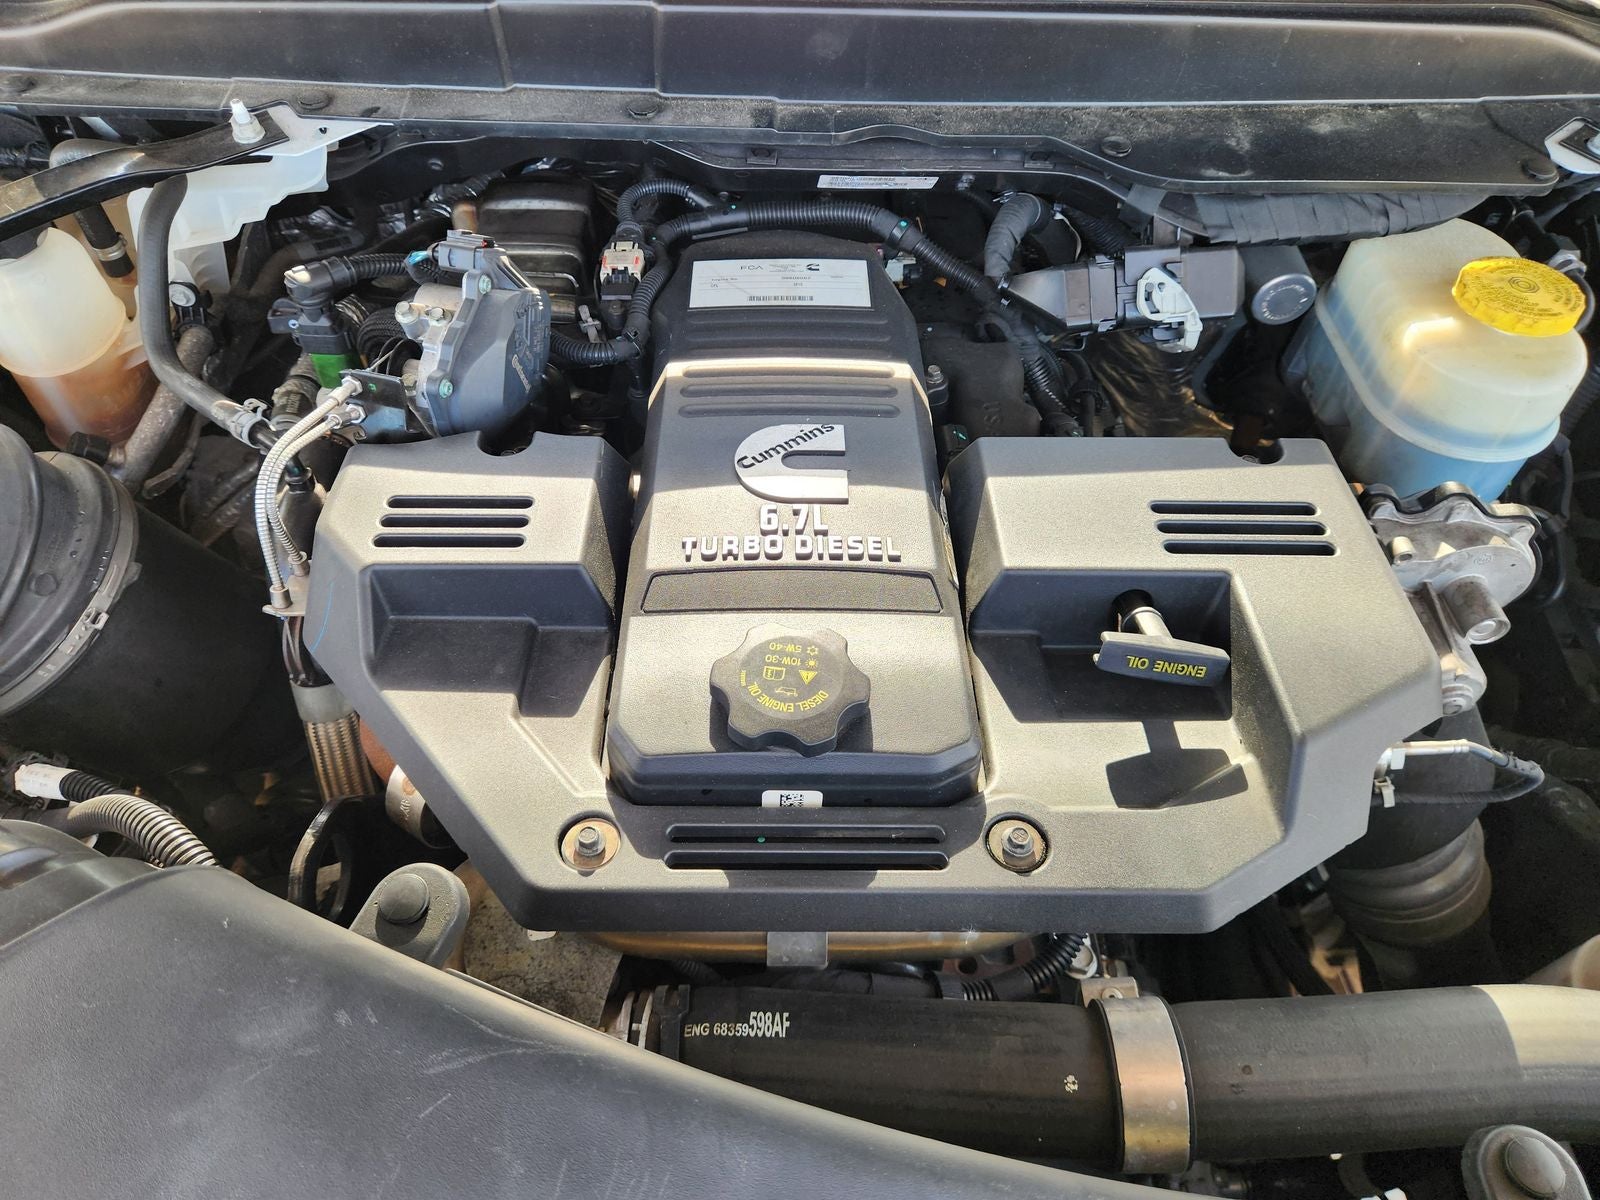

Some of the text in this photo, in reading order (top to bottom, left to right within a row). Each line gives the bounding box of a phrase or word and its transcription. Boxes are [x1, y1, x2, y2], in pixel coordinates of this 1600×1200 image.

[736, 423, 836, 469] Cummins
[759, 503, 829, 535] 6.7L
[682, 534, 902, 562] TURBO DIESEL
[765, 654, 802, 666] 10W-30
[769, 642, 802, 653] 5W-40
[1126, 655, 1207, 678] ENGINE OIL
[747, 681, 829, 713] DIESEL ENGINE OIL
[684, 1011, 791, 1038] ENG 68359598AF
